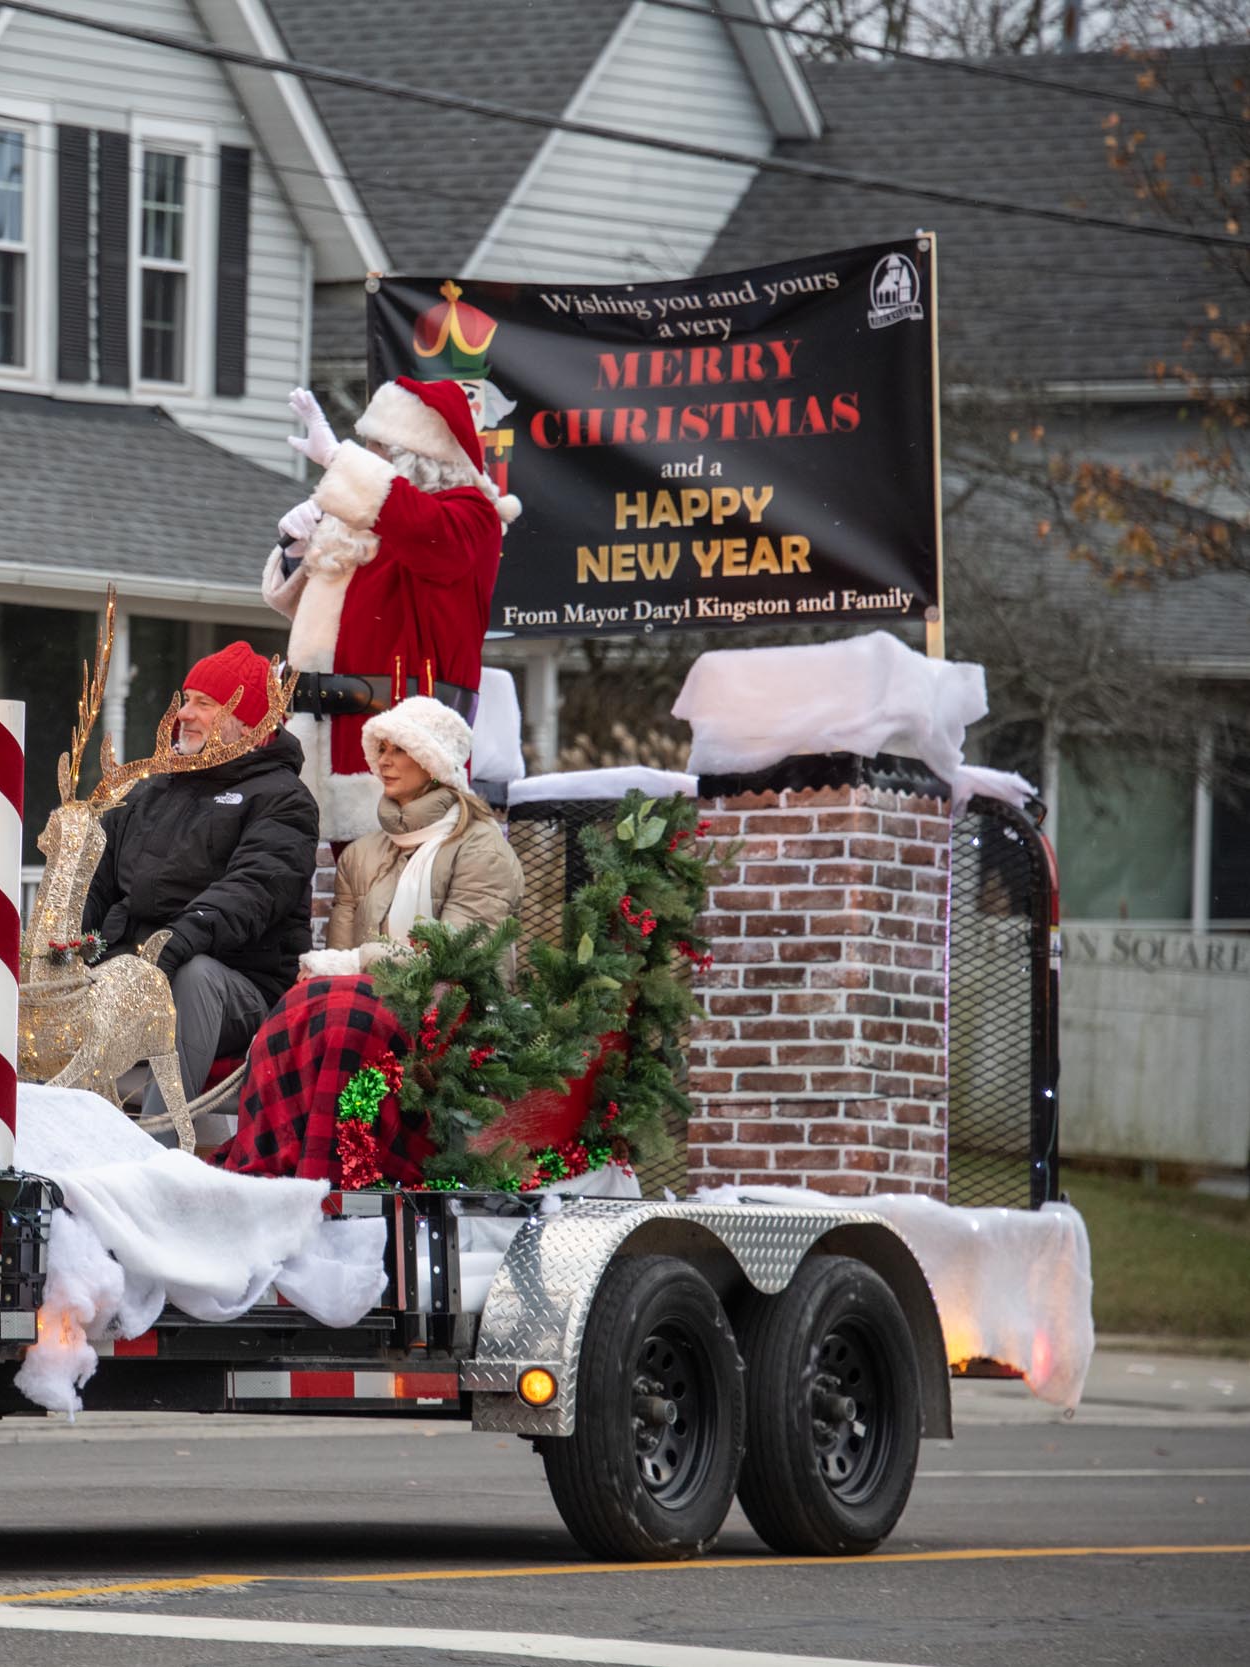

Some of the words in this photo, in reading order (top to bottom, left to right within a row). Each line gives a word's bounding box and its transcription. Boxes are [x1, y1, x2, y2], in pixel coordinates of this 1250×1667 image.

[540, 293, 652, 320] Wishing
[653, 295, 703, 317] you
[709, 281, 757, 308] and
[763, 271, 840, 305] yours
[657, 324, 674, 338] a
[678, 317, 732, 341] very
[592, 339, 802, 391] MERRY
[530, 392, 861, 449] CHRISTMAS
[660, 455, 703, 478] and
[709, 461, 723, 477] a
[615, 485, 774, 530] HAPPY
[576, 542, 680, 584] NEW
[692, 535, 812, 578] YEAR
[503, 606, 557, 626] From
[564, 602, 629, 629] Mayor
[634, 599, 691, 625] Daryl
[696, 595, 789, 623] Kingston
[795, 591, 835, 612] and
[842, 587, 914, 611] Family
